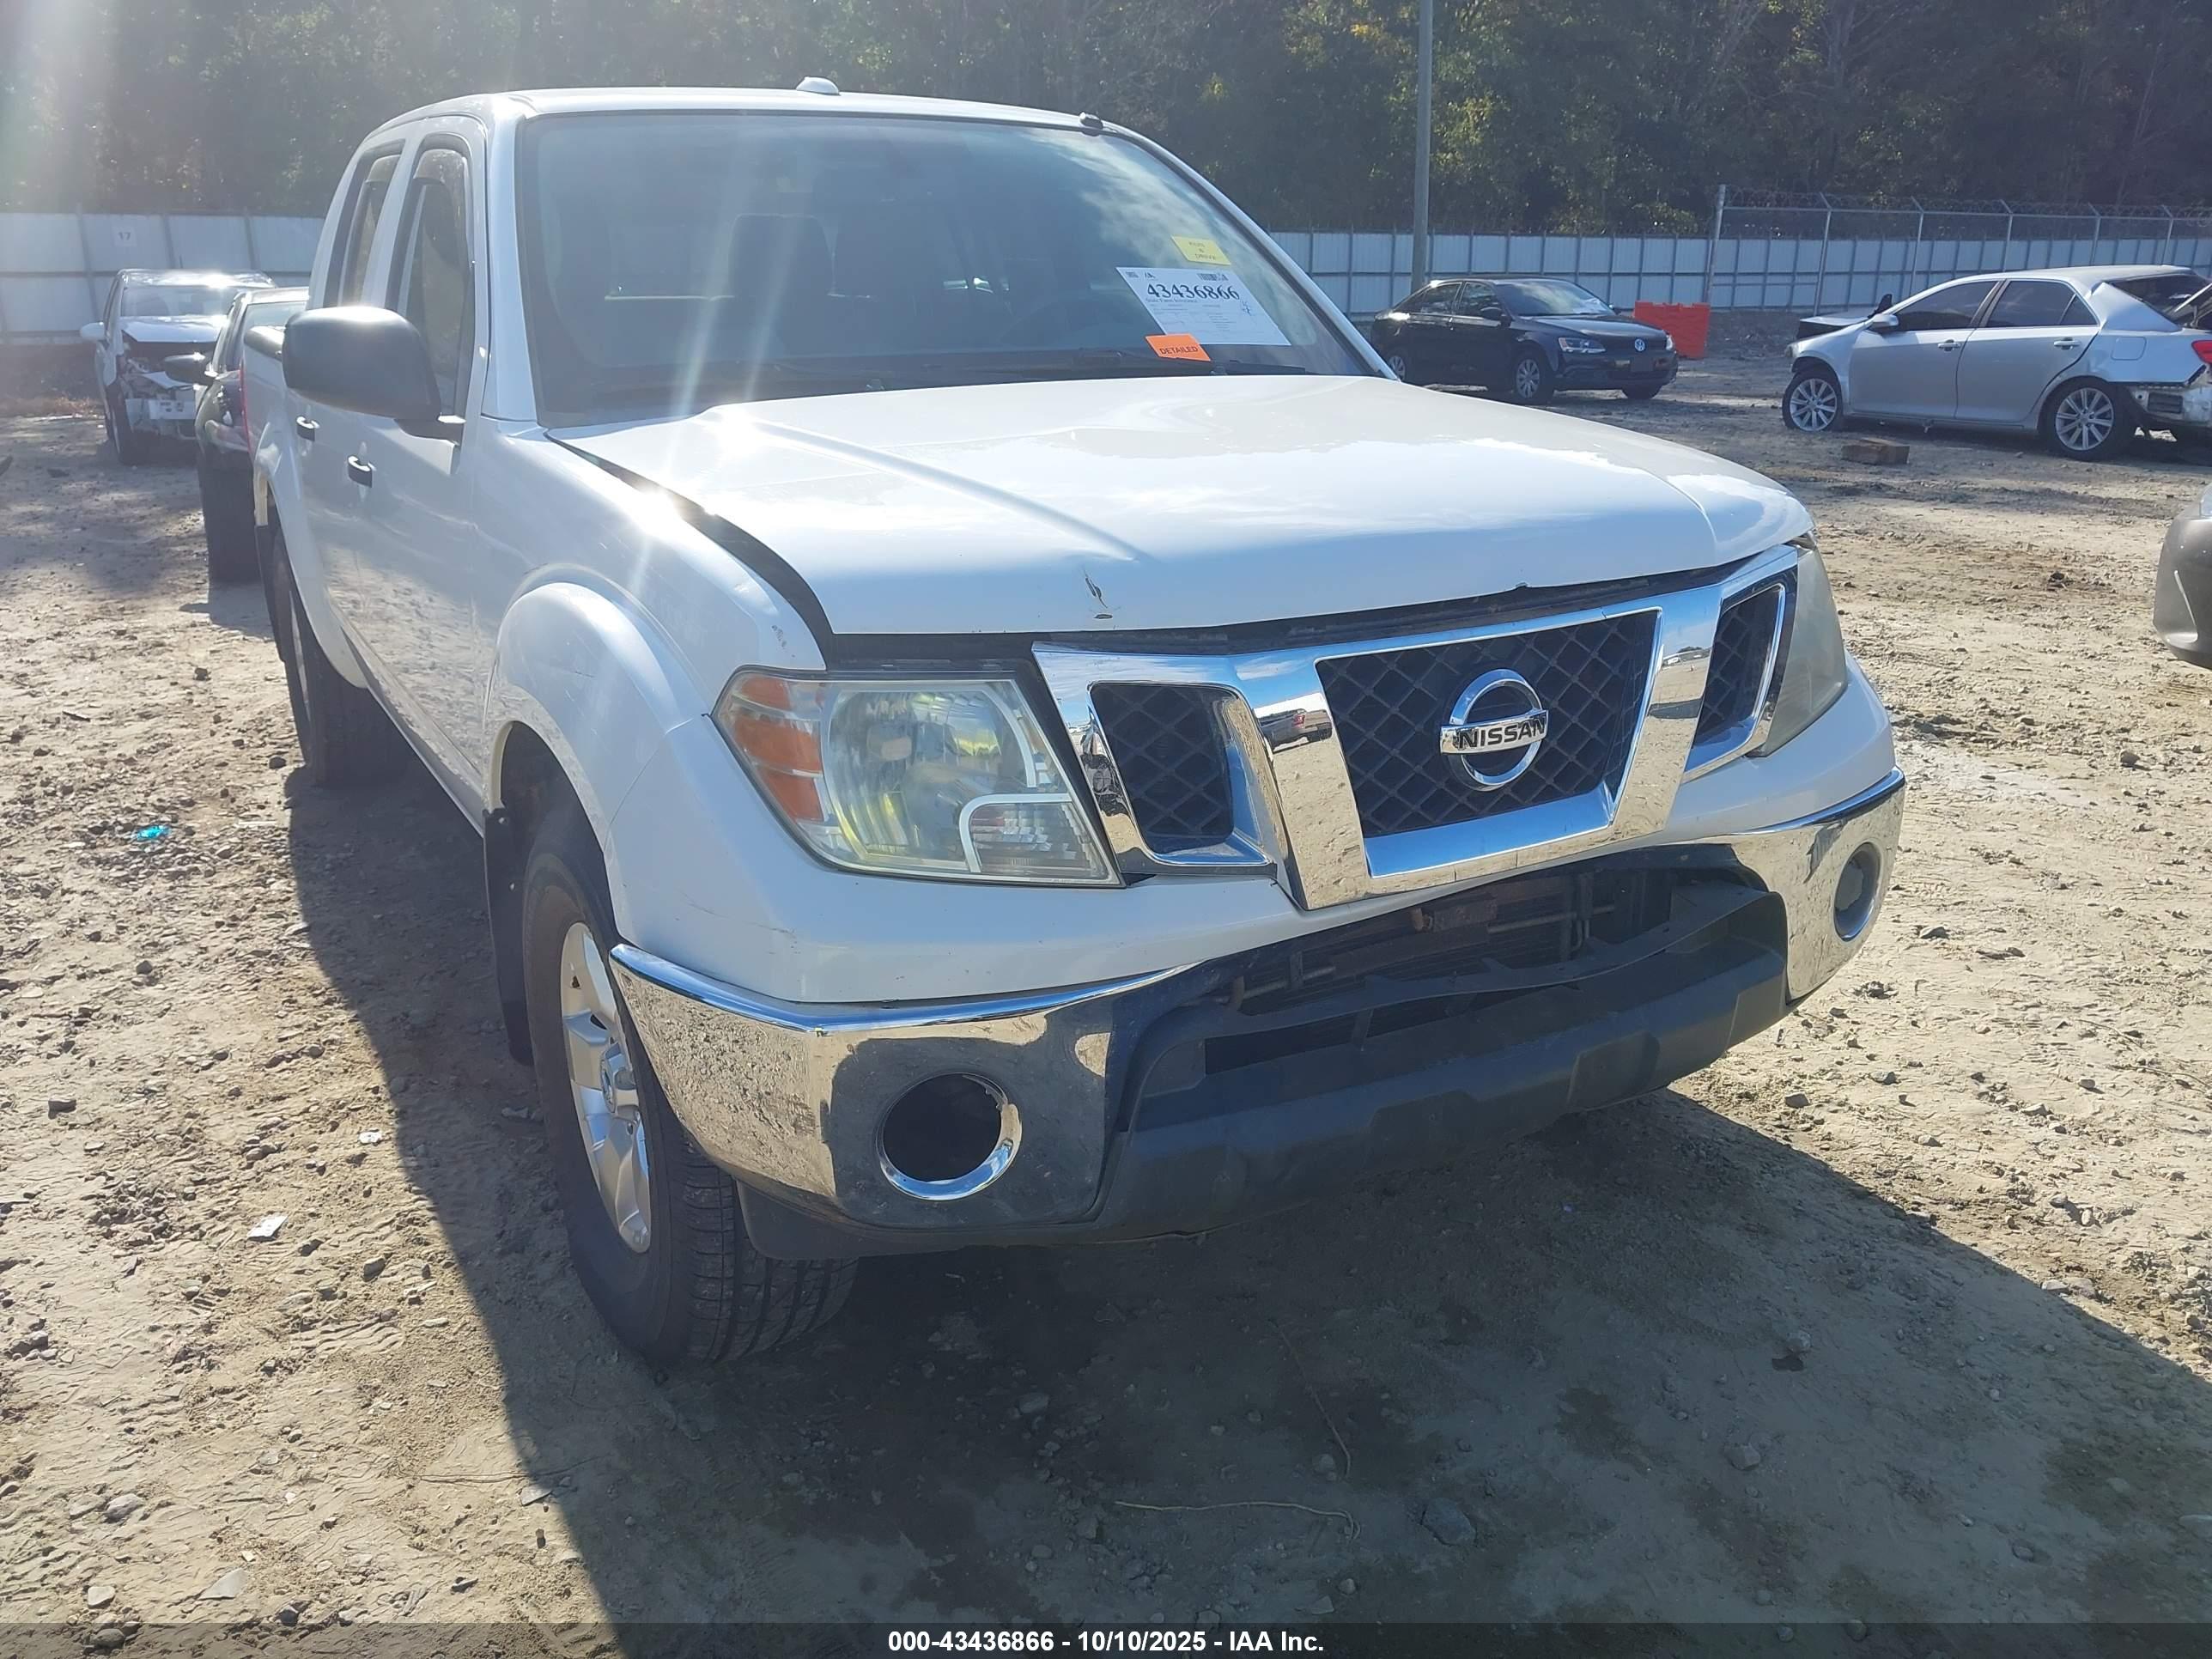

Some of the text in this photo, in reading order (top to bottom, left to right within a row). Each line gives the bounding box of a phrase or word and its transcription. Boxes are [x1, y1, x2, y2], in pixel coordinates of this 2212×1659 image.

[118, 232, 131, 241] 17
[1147, 283, 1239, 300] 43436866
[1159, 346, 1198, 355] DETAILED
[1459, 717, 1546, 748] NISSAN
